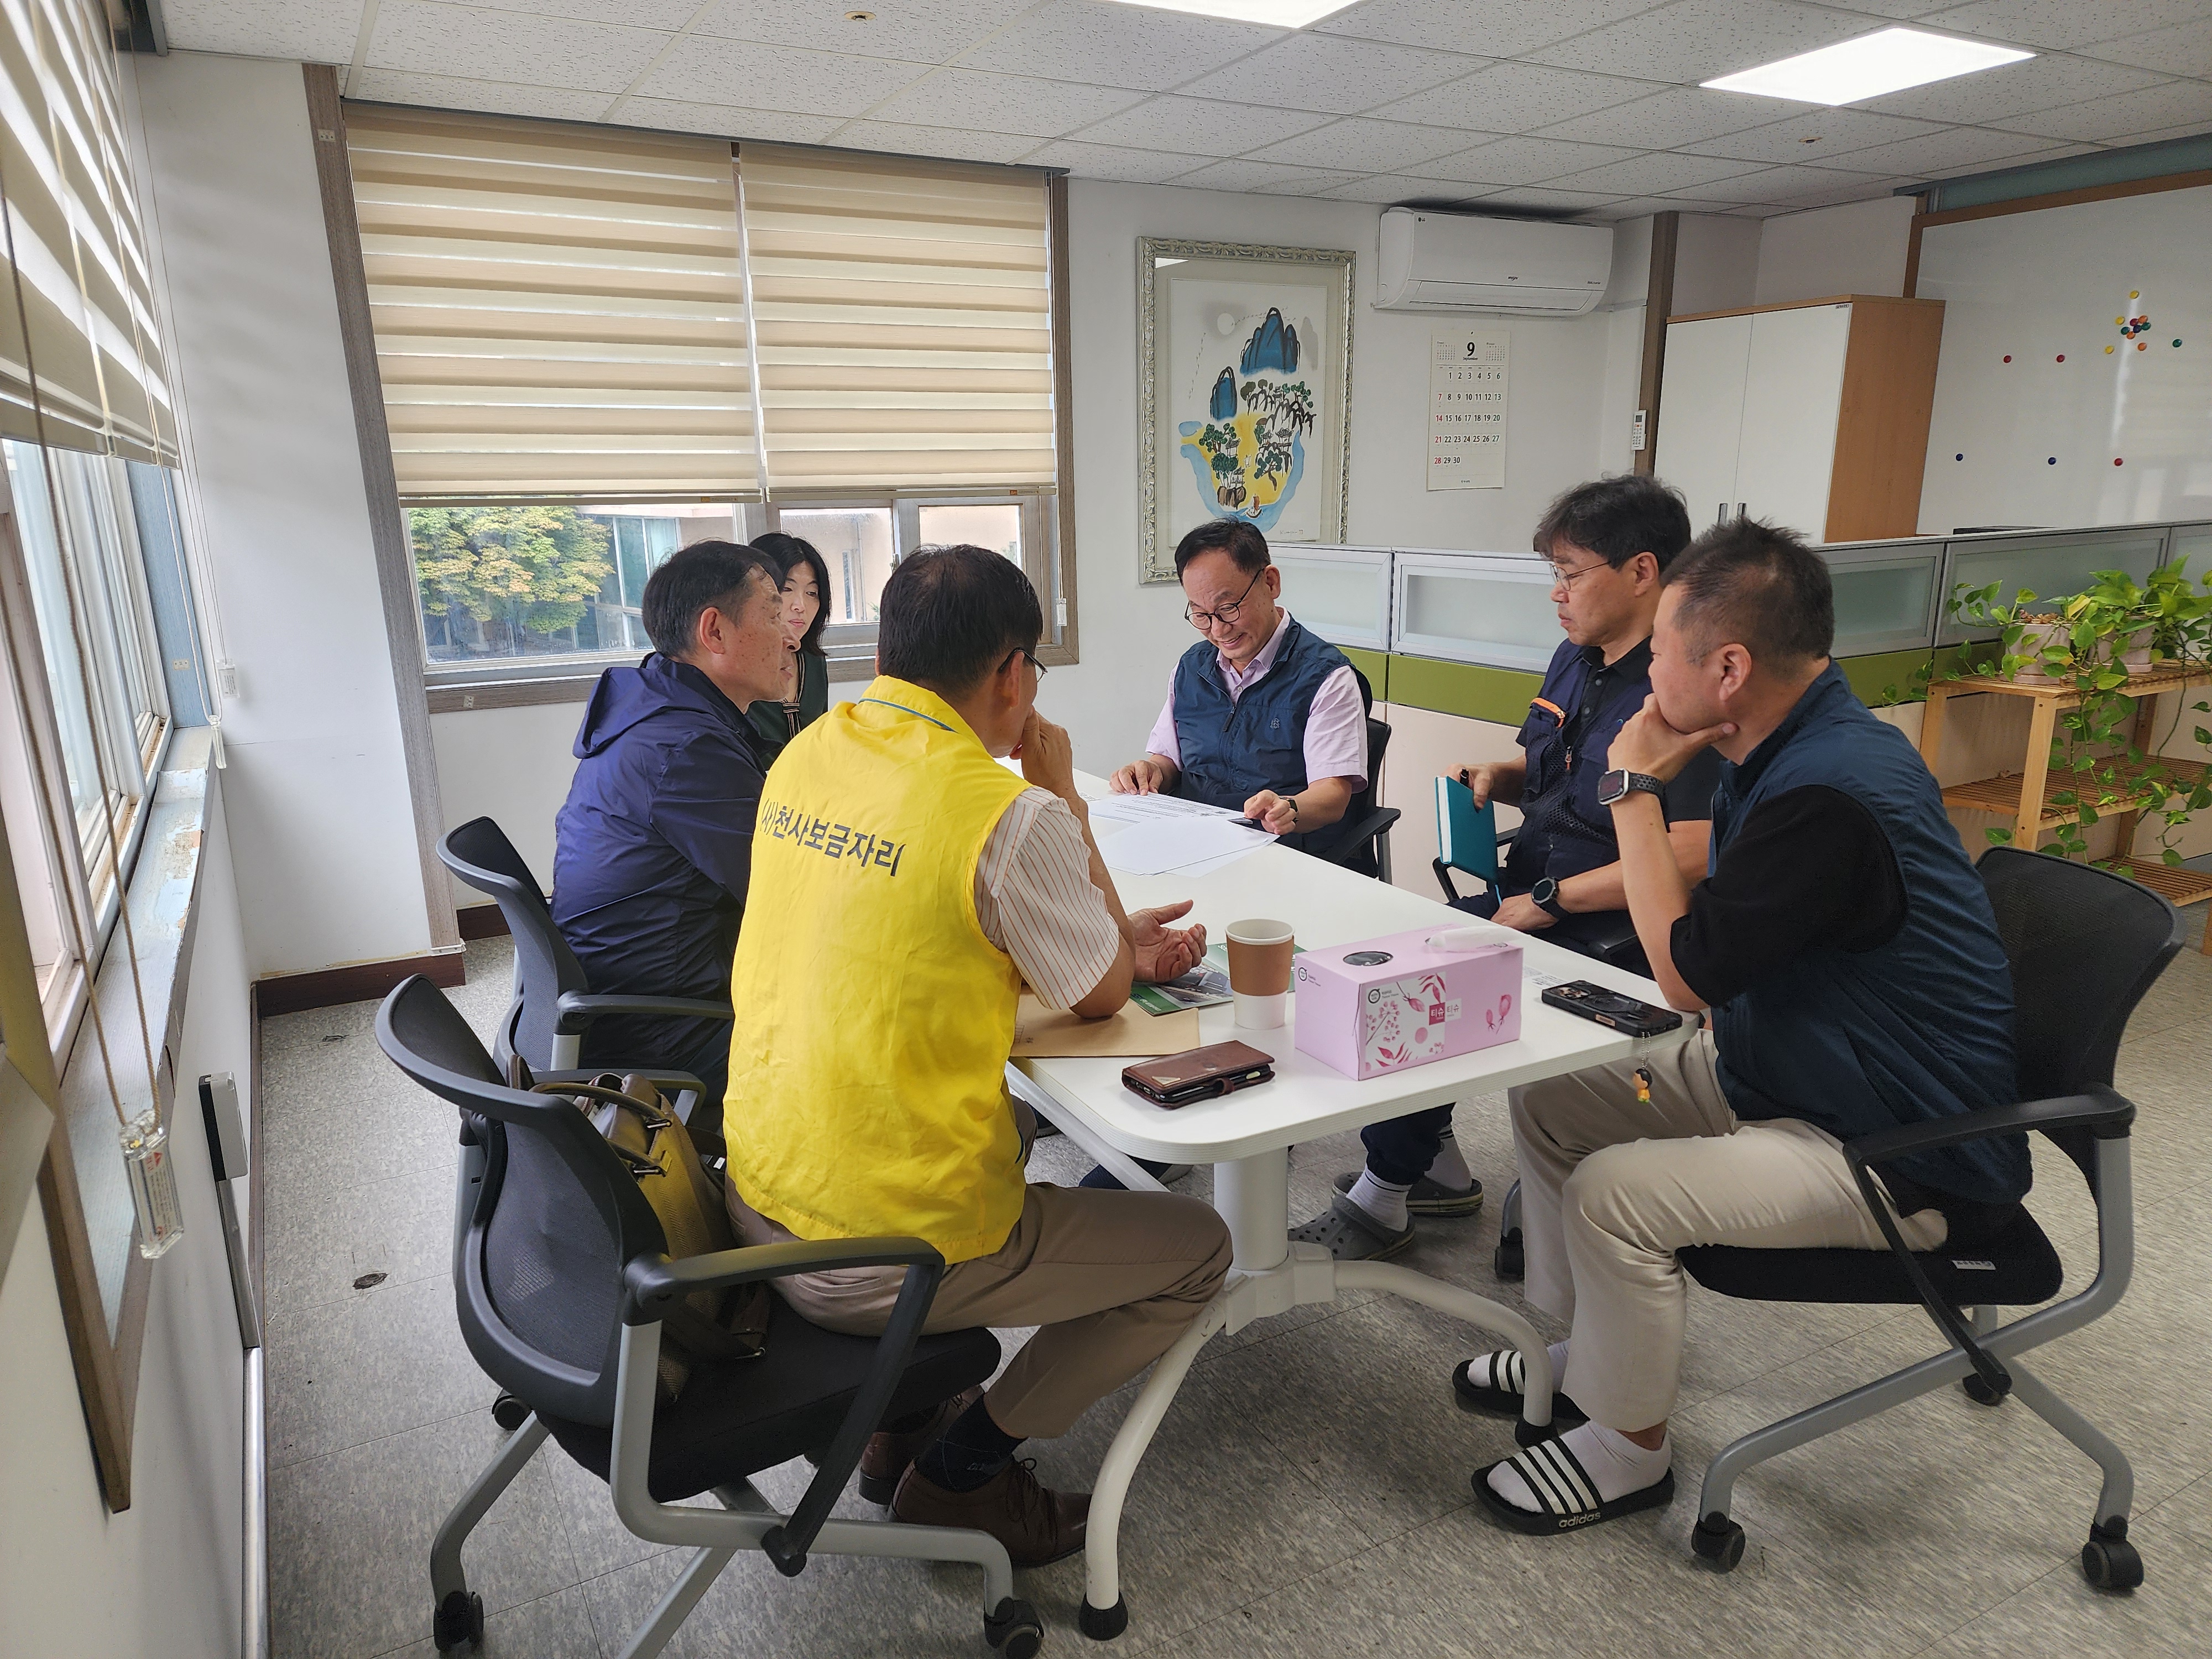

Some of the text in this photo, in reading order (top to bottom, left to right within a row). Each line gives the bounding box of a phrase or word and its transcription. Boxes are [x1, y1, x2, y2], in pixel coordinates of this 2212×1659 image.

[1467, 342, 1475, 357] 9
[760, 798, 906, 877] (사)천사보금자리
[1431, 1007, 1444, 1018] 티슈
[1447, 1004, 1459, 1014] 티슈
[1558, 1512, 1601, 1528] adidas
